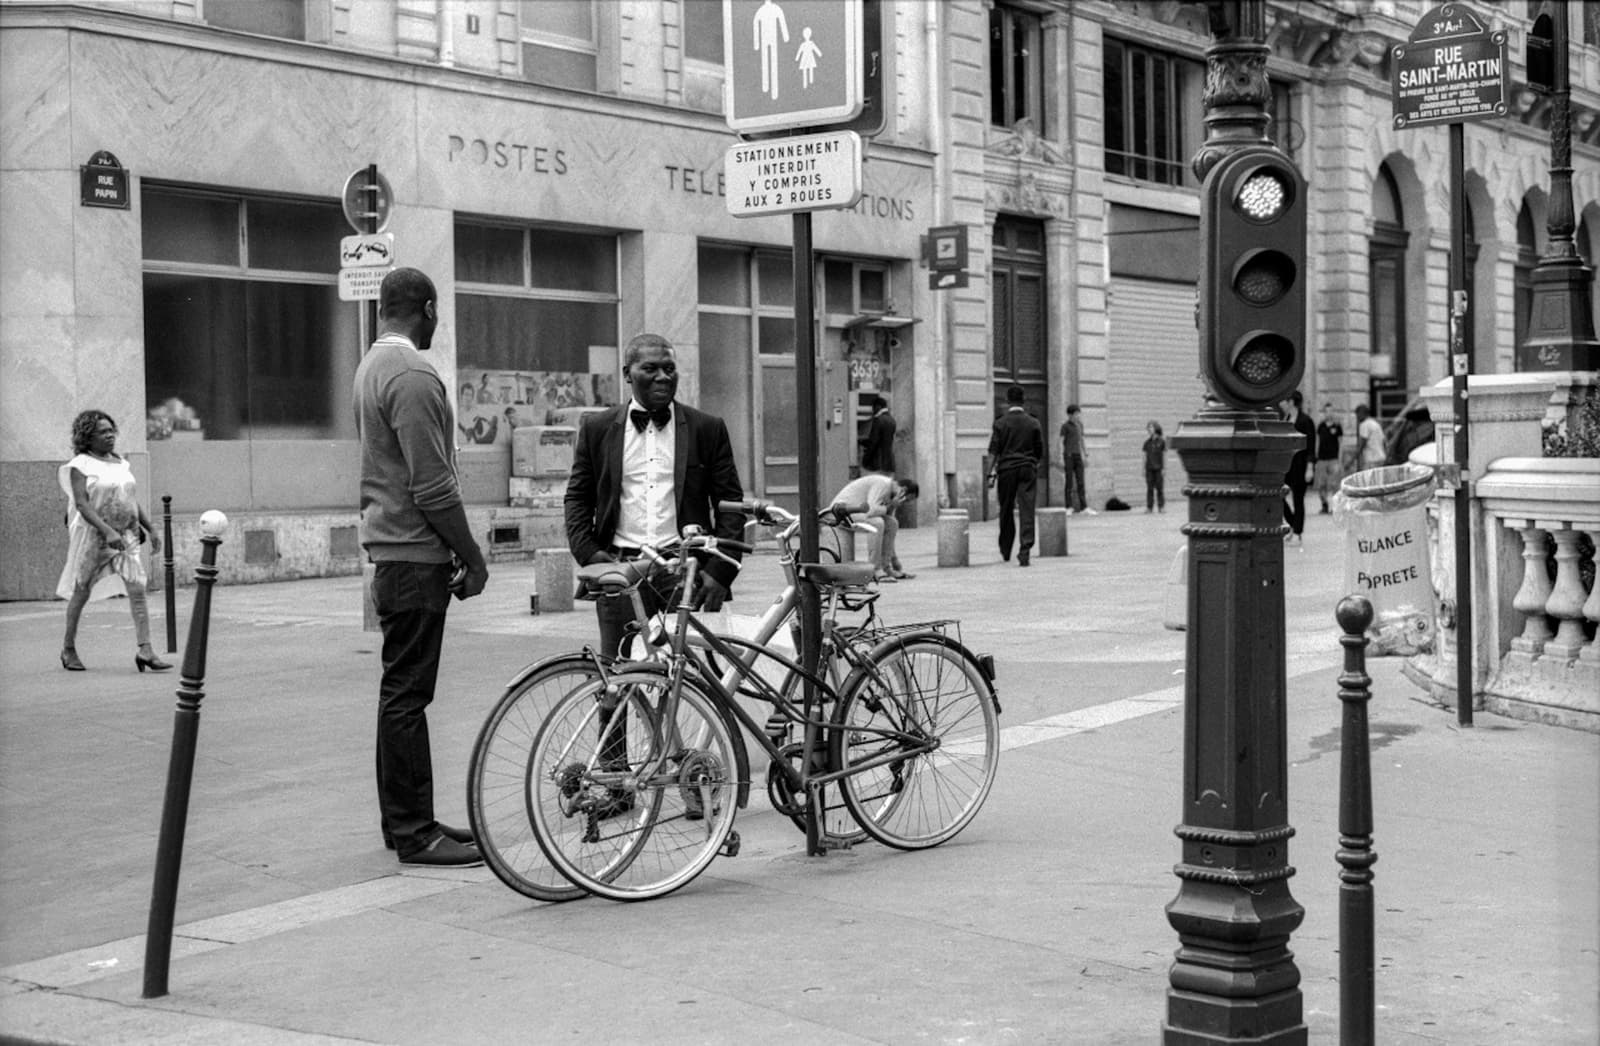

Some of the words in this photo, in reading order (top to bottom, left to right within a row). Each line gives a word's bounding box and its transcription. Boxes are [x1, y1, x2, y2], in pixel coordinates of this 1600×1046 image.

[1434, 45, 1463, 65] RUE
[1399, 58, 1500, 88] SAINT-MARTIN
[448, 134, 568, 176] POSTES
[735, 140, 840, 163] STATIONNEMENT
[757, 158, 816, 176] INTERDIT
[98, 175, 114, 186] RUE
[749, 180, 756, 192] Y
[764, 173, 822, 191] COMPRIS
[95, 188, 118, 199] PAPIN
[744, 194, 768, 208] AUX
[775, 193, 783, 205] 2
[790, 187, 832, 203] ROUES
[851, 359, 880, 378] 3639
